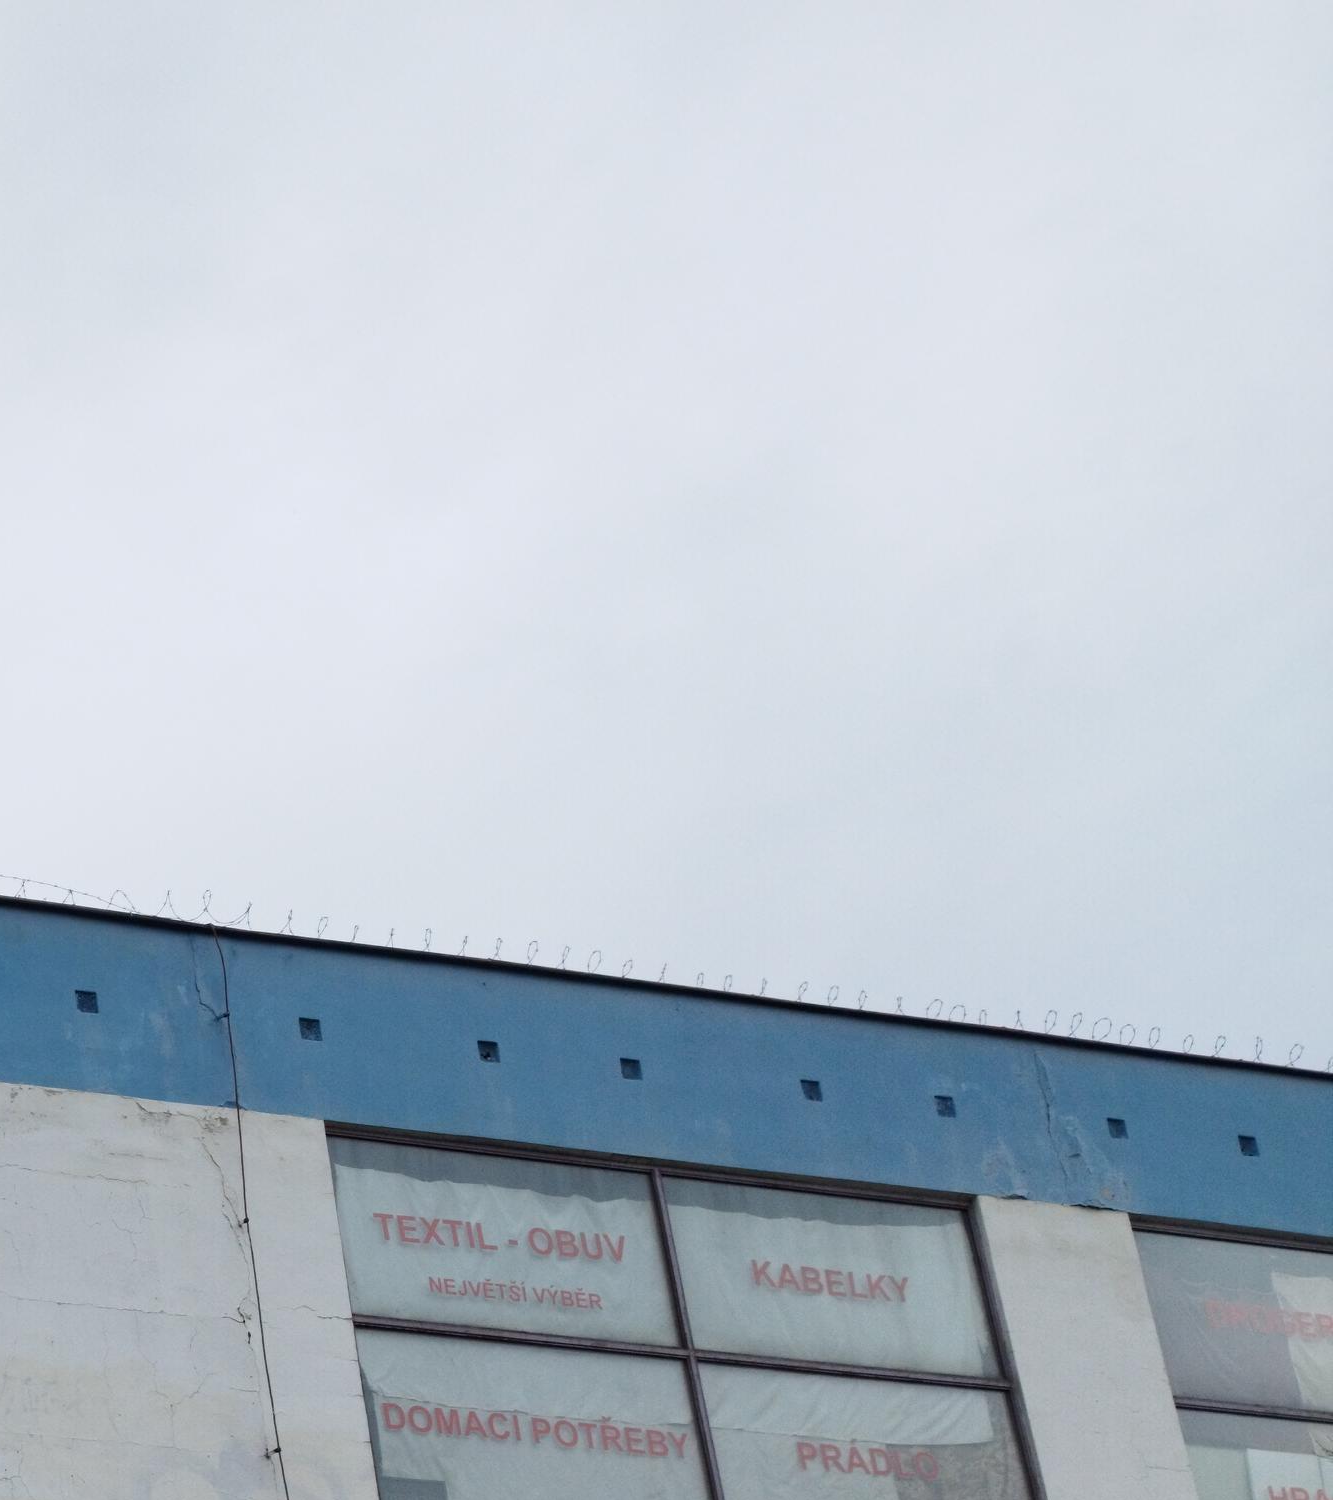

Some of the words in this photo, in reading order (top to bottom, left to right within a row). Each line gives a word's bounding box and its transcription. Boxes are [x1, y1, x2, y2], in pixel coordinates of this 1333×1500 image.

[372, 1212, 499, 1251] TEXTIL
[527, 1227, 626, 1263] OBUV
[428, 1275, 528, 1303] NEJVĚTŠÍ
[532, 1284, 604, 1311] VÝBĚR
[750, 1259, 909, 1303] KABELKY
[530, 1414, 689, 1459] POTŘEBY
